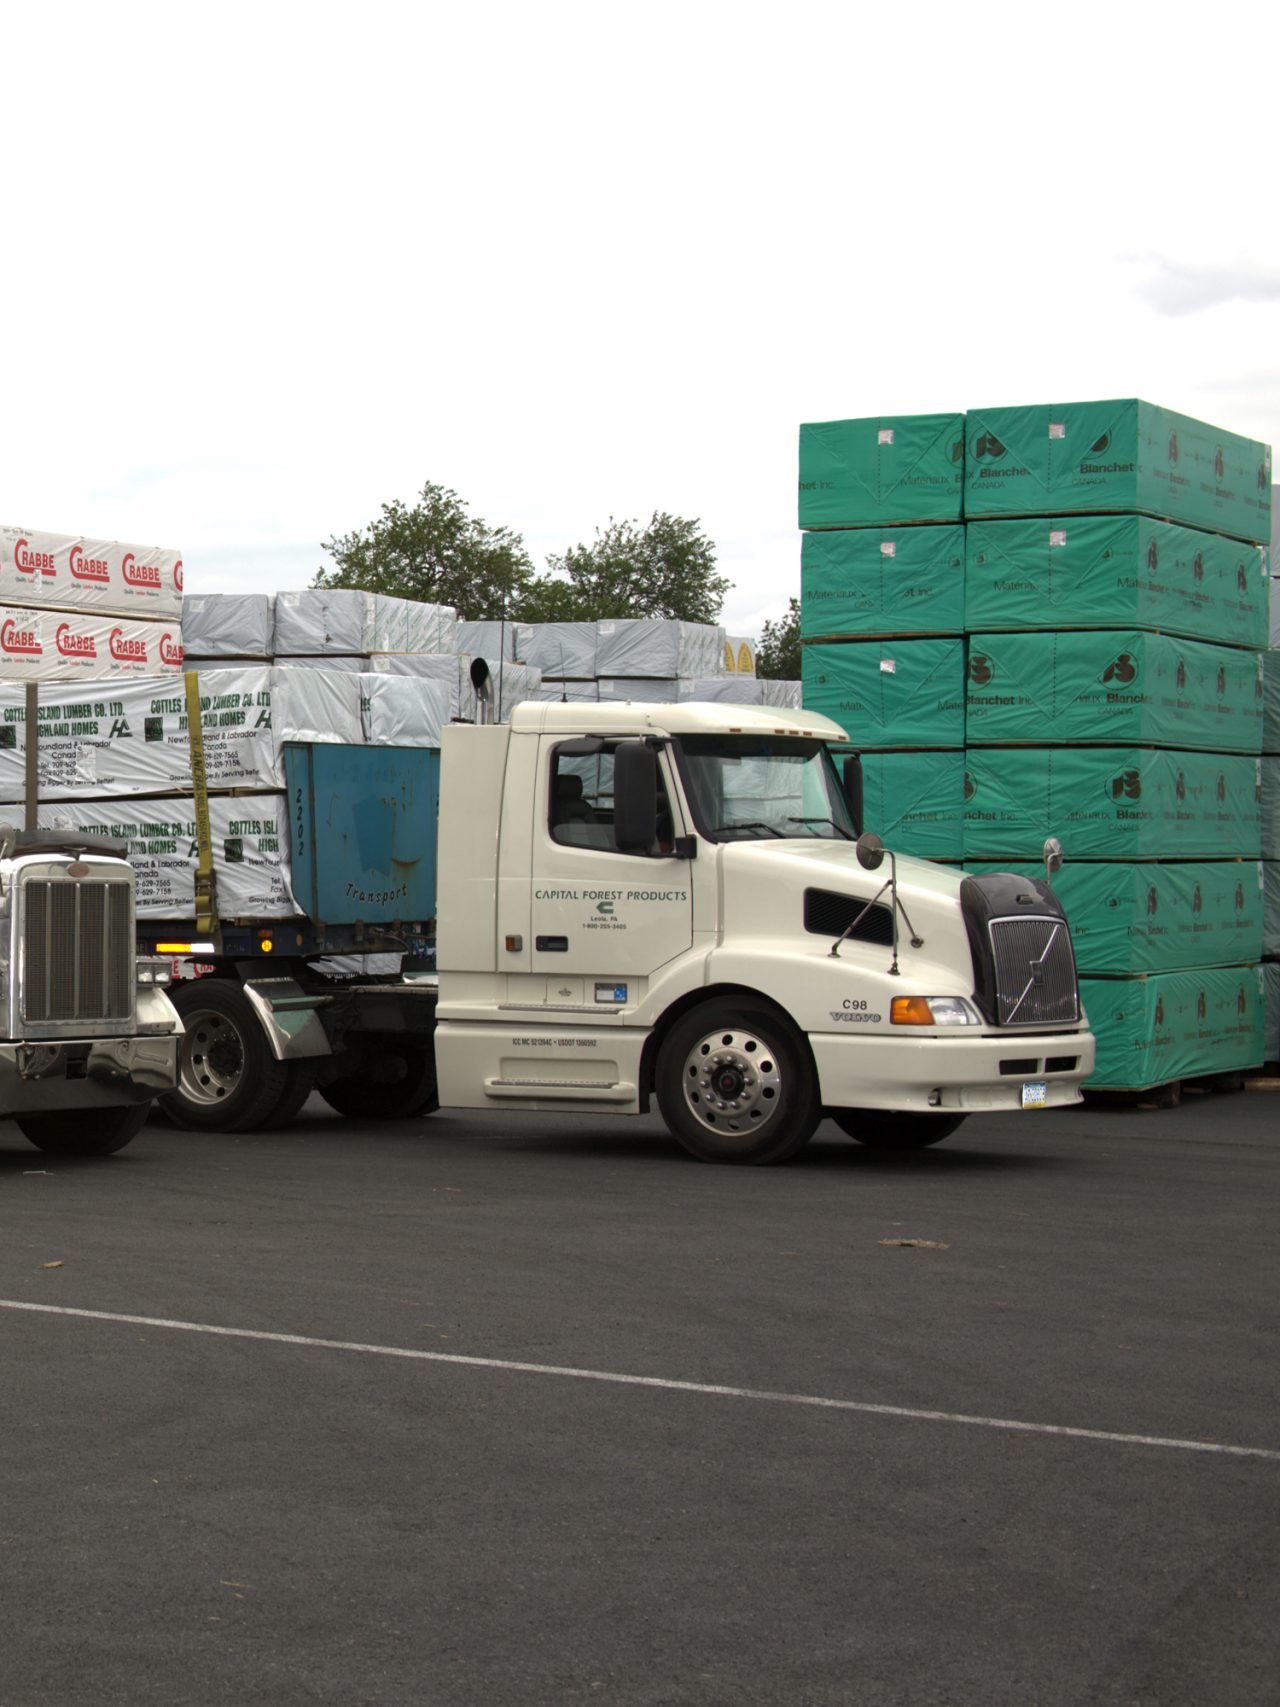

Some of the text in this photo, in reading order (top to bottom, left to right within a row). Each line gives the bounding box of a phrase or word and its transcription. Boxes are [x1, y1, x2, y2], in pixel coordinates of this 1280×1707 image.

[980, 467, 1031, 478] Blanche
[1080, 463, 1134, 474] Blanchet
[972, 481, 1005, 489] CANADA
[15, 539, 56, 576] CRABBE
[69, 546, 110, 582] CRABBE
[122, 553, 161, 588] CRABBE
[1, 619, 42, 654] CRABB
[56, 623, 96, 658] CRABBE
[109, 628, 147, 662] CRABBE
[63, 702, 125, 718] LUMBER CO. LTD.
[151, 699, 181, 713] COTTLES
[213, 694, 240, 710] LUMBER
[220, 712, 246, 726] HOMES
[72, 722, 98, 736] HOMES
[227, 731, 257, 739] Labrador
[111, 824, 137, 838] ISLAND
[140, 823, 169, 837] LUMBER
[172, 823, 185, 837] CO.
[229, 821, 261, 836] COTTLES
[148, 841, 176, 854] HOMES
[346, 883, 407, 906] Transport
[535, 890, 687, 901] CAPITAL FOREST PRODUCTS
[842, 1000, 867, 1010] C98
[830, 1012, 882, 1023] VOLVO
